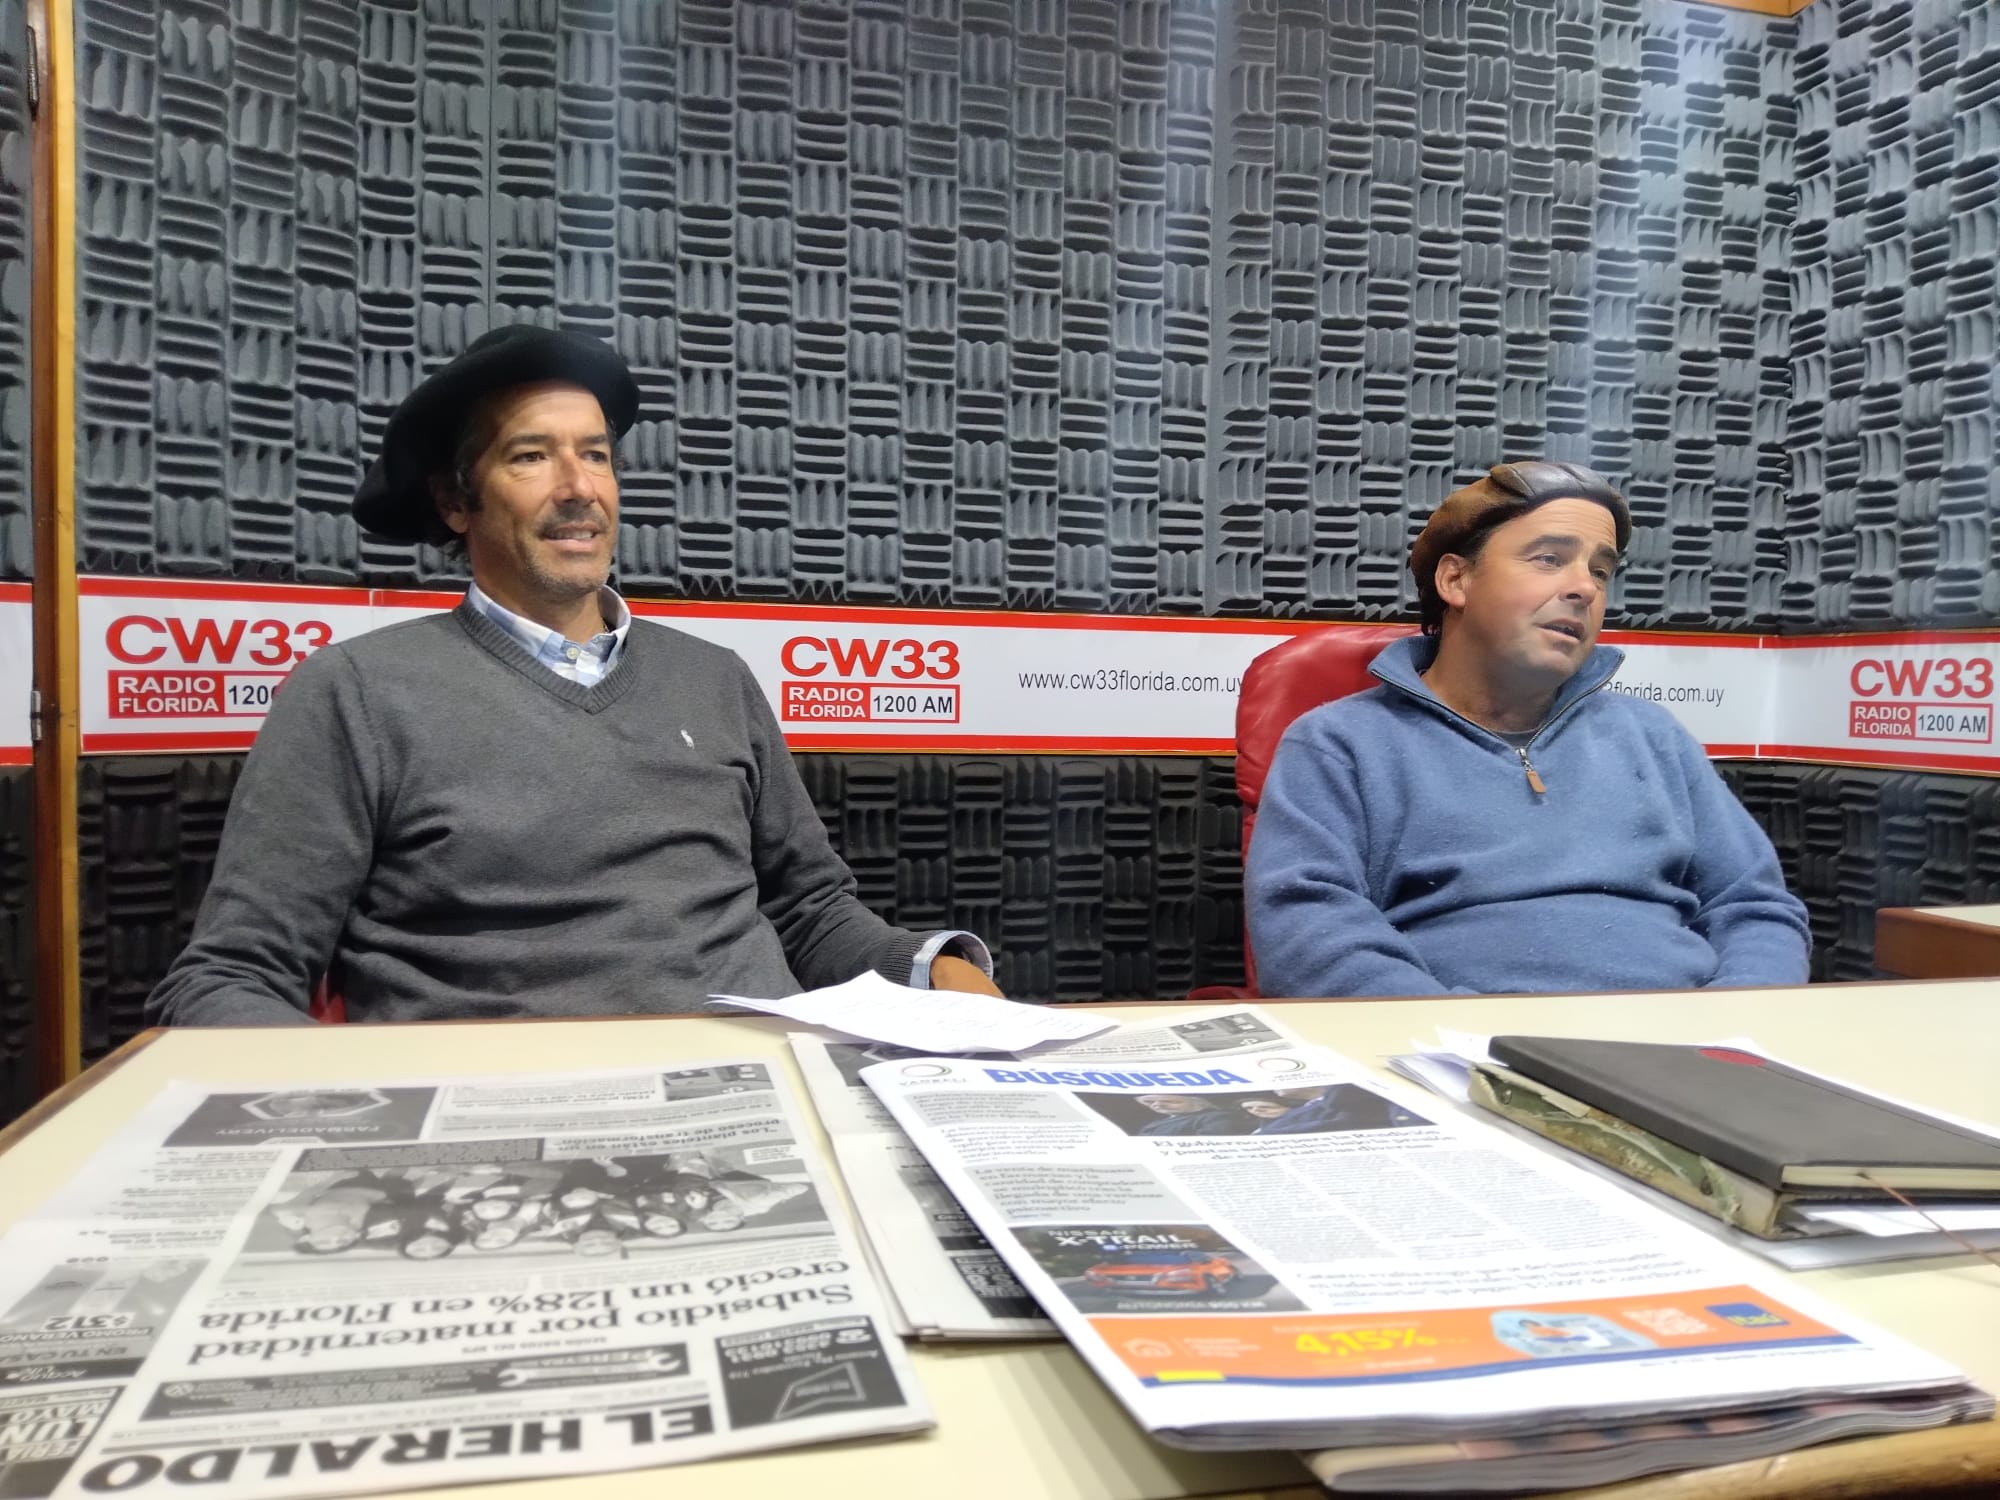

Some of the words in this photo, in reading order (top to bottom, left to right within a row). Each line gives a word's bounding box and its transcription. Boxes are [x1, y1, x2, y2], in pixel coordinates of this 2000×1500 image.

[106, 615, 332, 667] CW33
[781, 636, 961, 681] CW33
[118, 676, 216, 694] RADIO
[1849, 658, 1994, 699] CW33
[118, 696, 219, 713] FLORIDA
[228, 685, 277, 705] 120
[789, 686, 864, 703] RADIO
[872, 694, 917, 714] 1200
[923, 695, 954, 715] AM
[788, 704, 866, 719] FLORIDA
[1855, 706, 1912, 721] RADIO
[1854, 721, 1913, 737] FLORIDA
[1918, 713, 1956, 733] 1200
[1960, 716, 1987, 734] AM
[982, 1067, 1253, 1089] BÚSQUEDA
[1055, 1233, 1192, 1248] X-TRAIL
[708, 1258, 850, 1295] creció
[489, 1288, 614, 1317] 128%
[629, 1283, 692, 1301] un
[412, 1298, 474, 1317] en
[636, 1283, 853, 1327] Subsidio
[45, 1313, 129, 1331] $312
[198, 1302, 396, 1335] Florida
[527, 1308, 621, 1334] por
[187, 1321, 516, 1366] maternidad
[1296, 1329, 1438, 1356] 4,15%
[8, 1400, 110, 1422] MAYO
[604, 1403, 716, 1445] EL
[4, 1440, 83, 1463] FERIA
[80, 1419, 582, 1493] HERALDO
